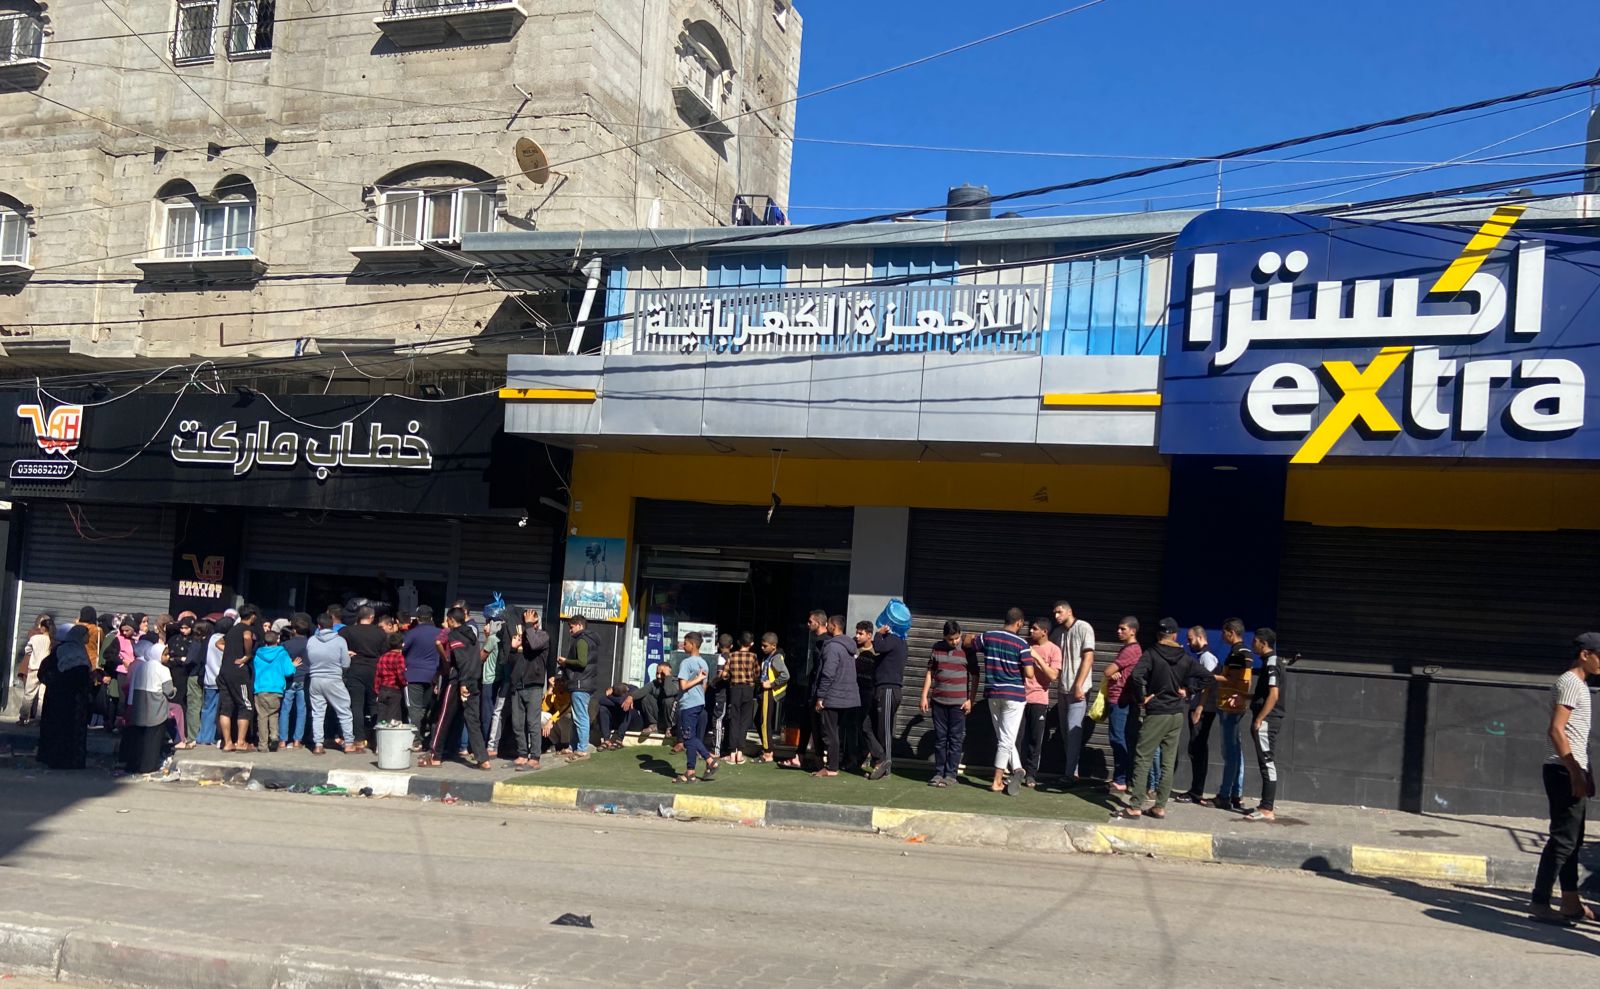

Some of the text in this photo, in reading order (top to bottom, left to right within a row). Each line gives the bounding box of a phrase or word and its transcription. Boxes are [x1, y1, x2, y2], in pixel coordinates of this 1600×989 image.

[1188, 205, 1546, 366] اكسترا
[645, 287, 1024, 347] للأجهزة الكهربائية
[1246, 345, 1586, 464] extra
[17, 464, 69, 475] 0598892207
[171, 420, 432, 480] خطاب ماركت
[178, 587, 221, 599] MARKET
[564, 605, 619, 621] BATTLEGROUNDS
